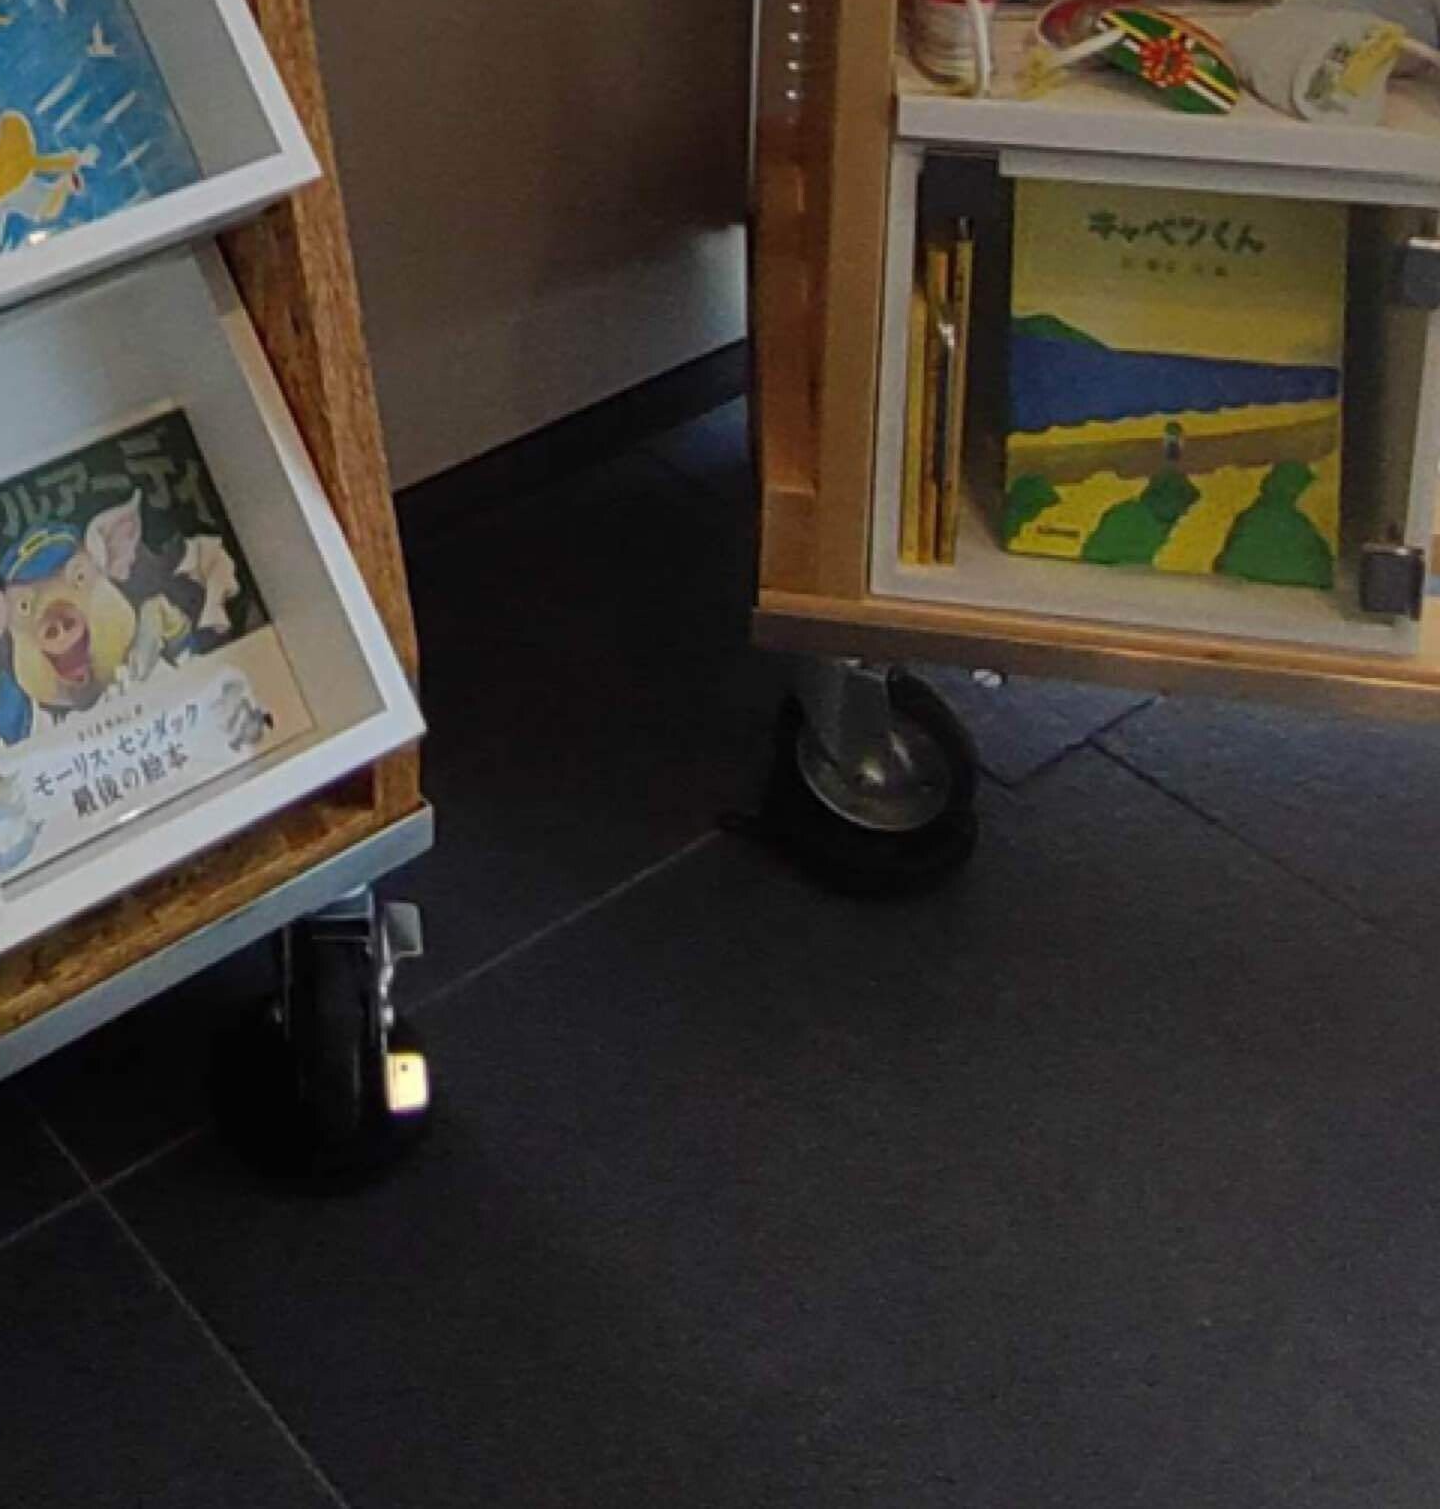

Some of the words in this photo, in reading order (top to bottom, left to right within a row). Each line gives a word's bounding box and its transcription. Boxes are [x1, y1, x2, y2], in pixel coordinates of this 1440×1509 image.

[1087, 209, 1267, 255] キャベツくん
[31, 702, 201, 798] モーリス・センダック
[71, 740, 189, 818] 最後の絵本
